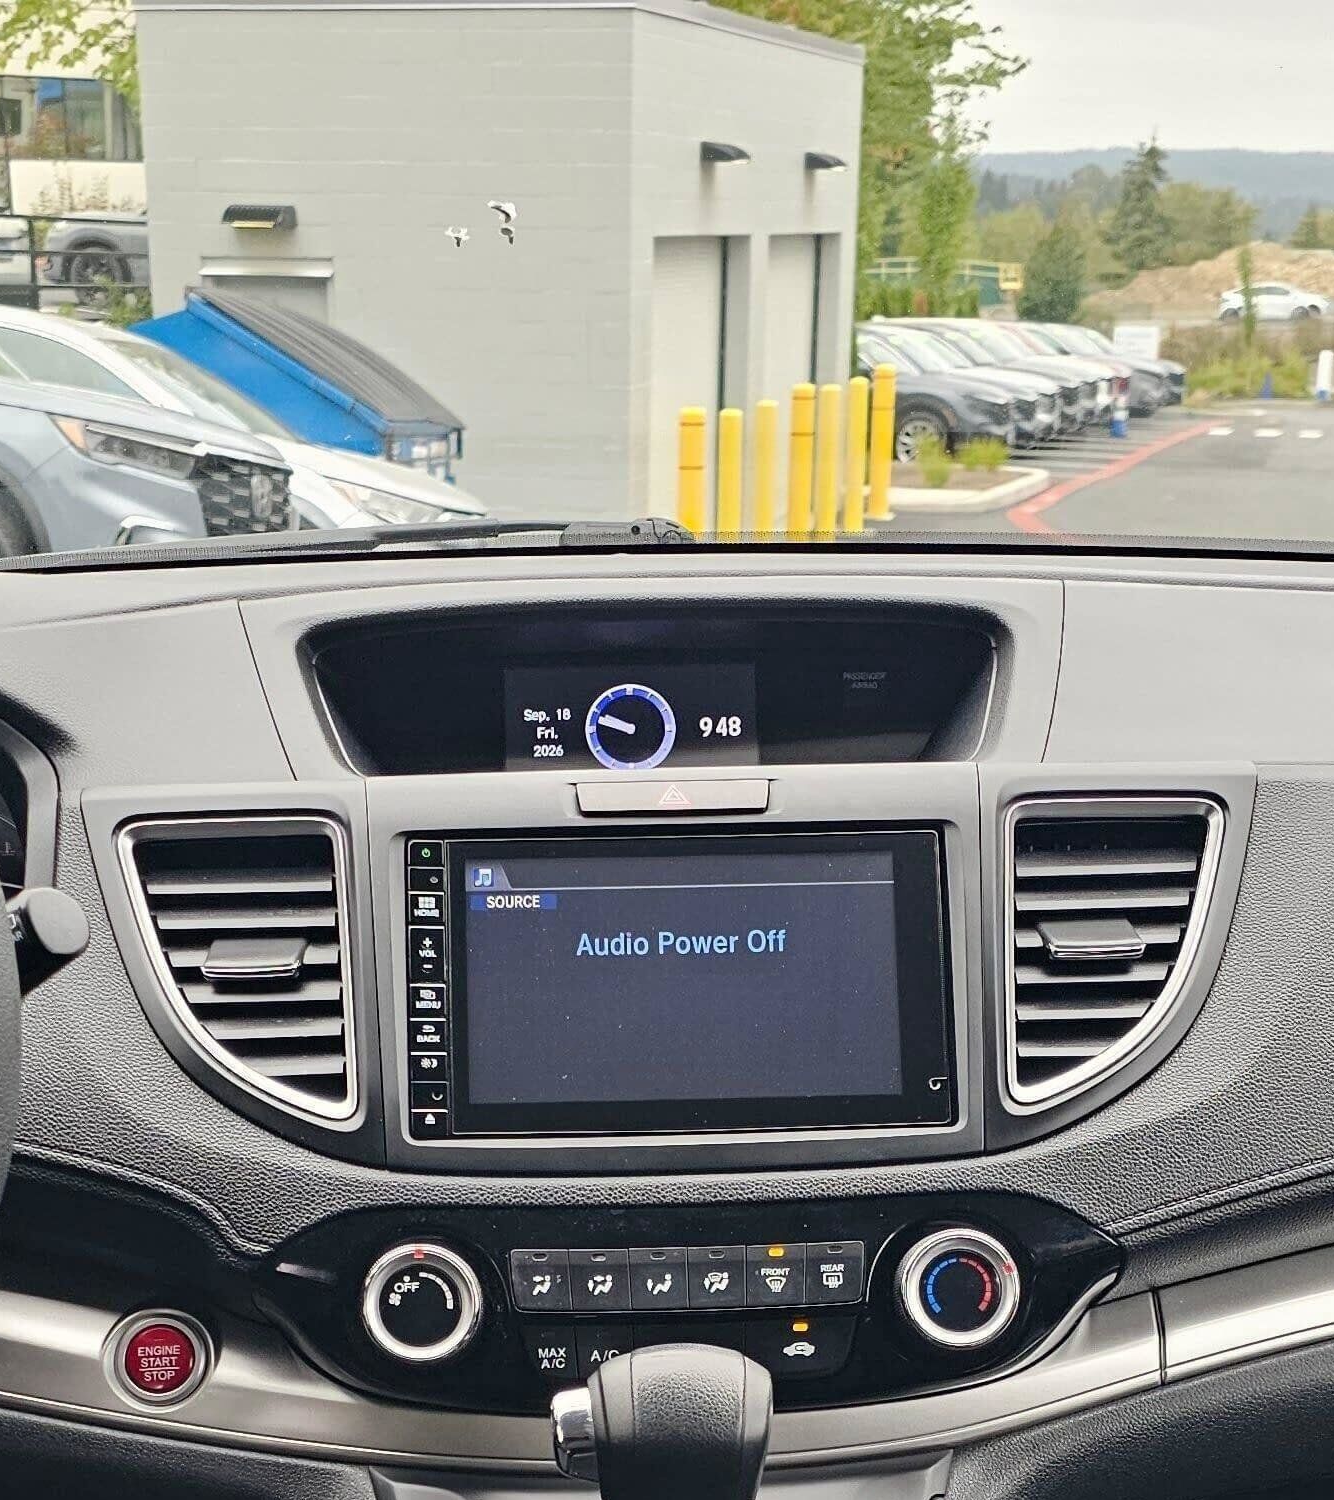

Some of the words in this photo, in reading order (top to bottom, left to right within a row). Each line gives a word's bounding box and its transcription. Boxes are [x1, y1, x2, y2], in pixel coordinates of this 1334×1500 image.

[523, 708, 551, 722] Sep.
[556, 708, 572, 721] 18
[537, 727, 559, 740] Fri.
[533, 744, 565, 758] 2026
[486, 894, 541, 909] SOURCE
[576, 932, 650, 957] Audio
[658, 930, 739, 955] Power
[747, 928, 787, 953] Off
[418, 949, 437, 958] VOL
[760, 1267, 790, 1276] FRONT
[820, 1263, 845, 1272] REAR
[394, 1281, 421, 1293] OFF
[137, 1345, 181, 1357] ENGINE
[538, 1347, 567, 1359] MAX
[140, 1356, 178, 1368] START
[540, 1358, 566, 1370] A/C
[144, 1370, 176, 1382] STOP
